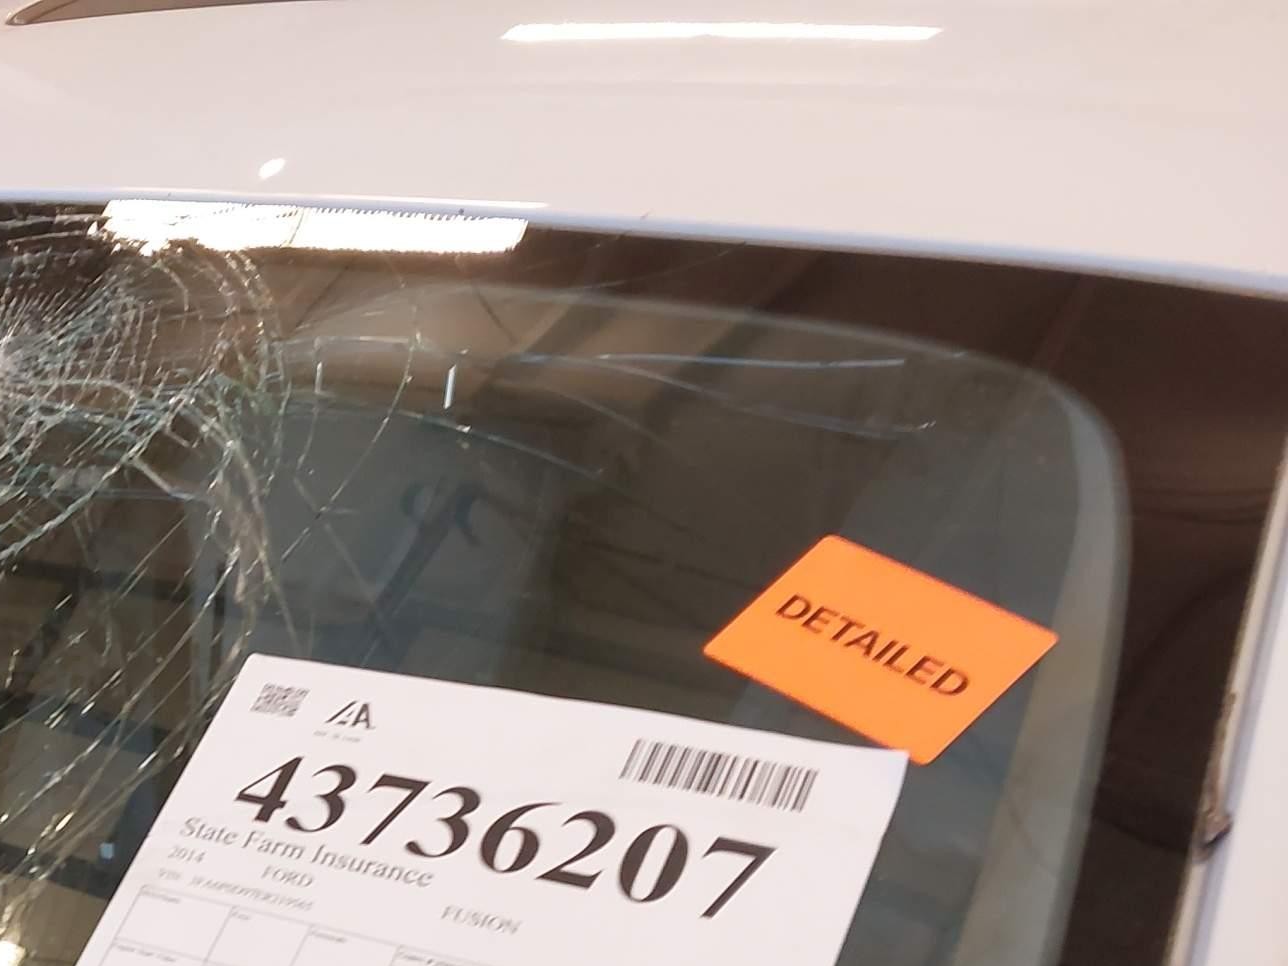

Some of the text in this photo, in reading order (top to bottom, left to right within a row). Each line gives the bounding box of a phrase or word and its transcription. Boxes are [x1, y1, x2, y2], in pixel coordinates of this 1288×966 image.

[775, 594, 970, 696] DETAILED
[180, 816, 435, 889] State Farm Insurance
[235, 756, 778, 919] 43736207
[168, 845, 523, 935] 2014 FORD FUSION
